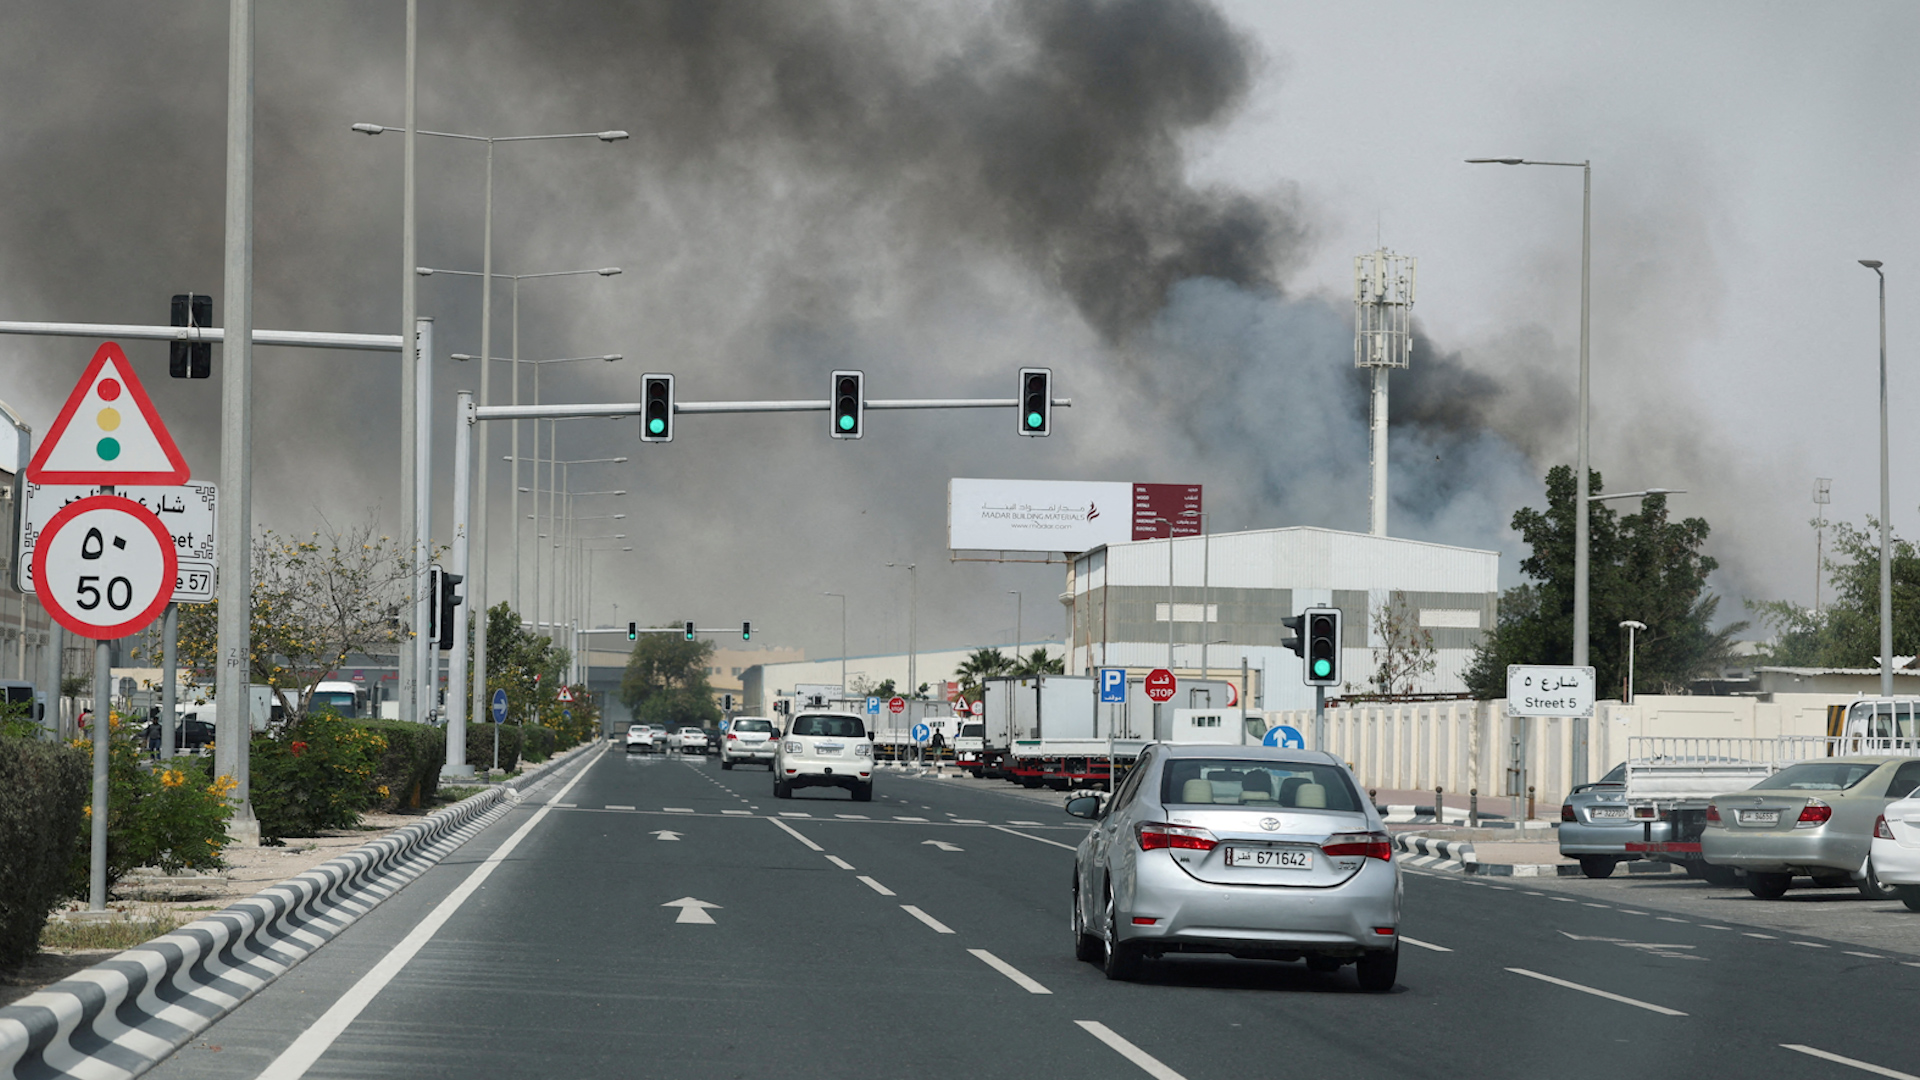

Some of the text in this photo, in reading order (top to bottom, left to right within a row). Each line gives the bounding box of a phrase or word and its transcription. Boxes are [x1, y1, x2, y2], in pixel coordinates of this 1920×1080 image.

[982, 511, 1085, 521] MADAR BUILDING MATERIALS
[1011, 520, 1072, 529] www.madar.com
[81, 527, 127, 560] ٥٠
[189, 574, 208, 591] 57
[76, 576, 133, 611] 50
[227, 659, 239, 668] FP
[1105, 671, 1121, 692] P
[1151, 674, 1170, 684] قف
[1524, 676, 1579, 691] شارع ٥
[1150, 688, 1173, 697] STOP
[869, 698, 877, 709] P
[1525, 697, 1577, 708] Street 5
[1236, 851, 1306, 866] قطر 671642
